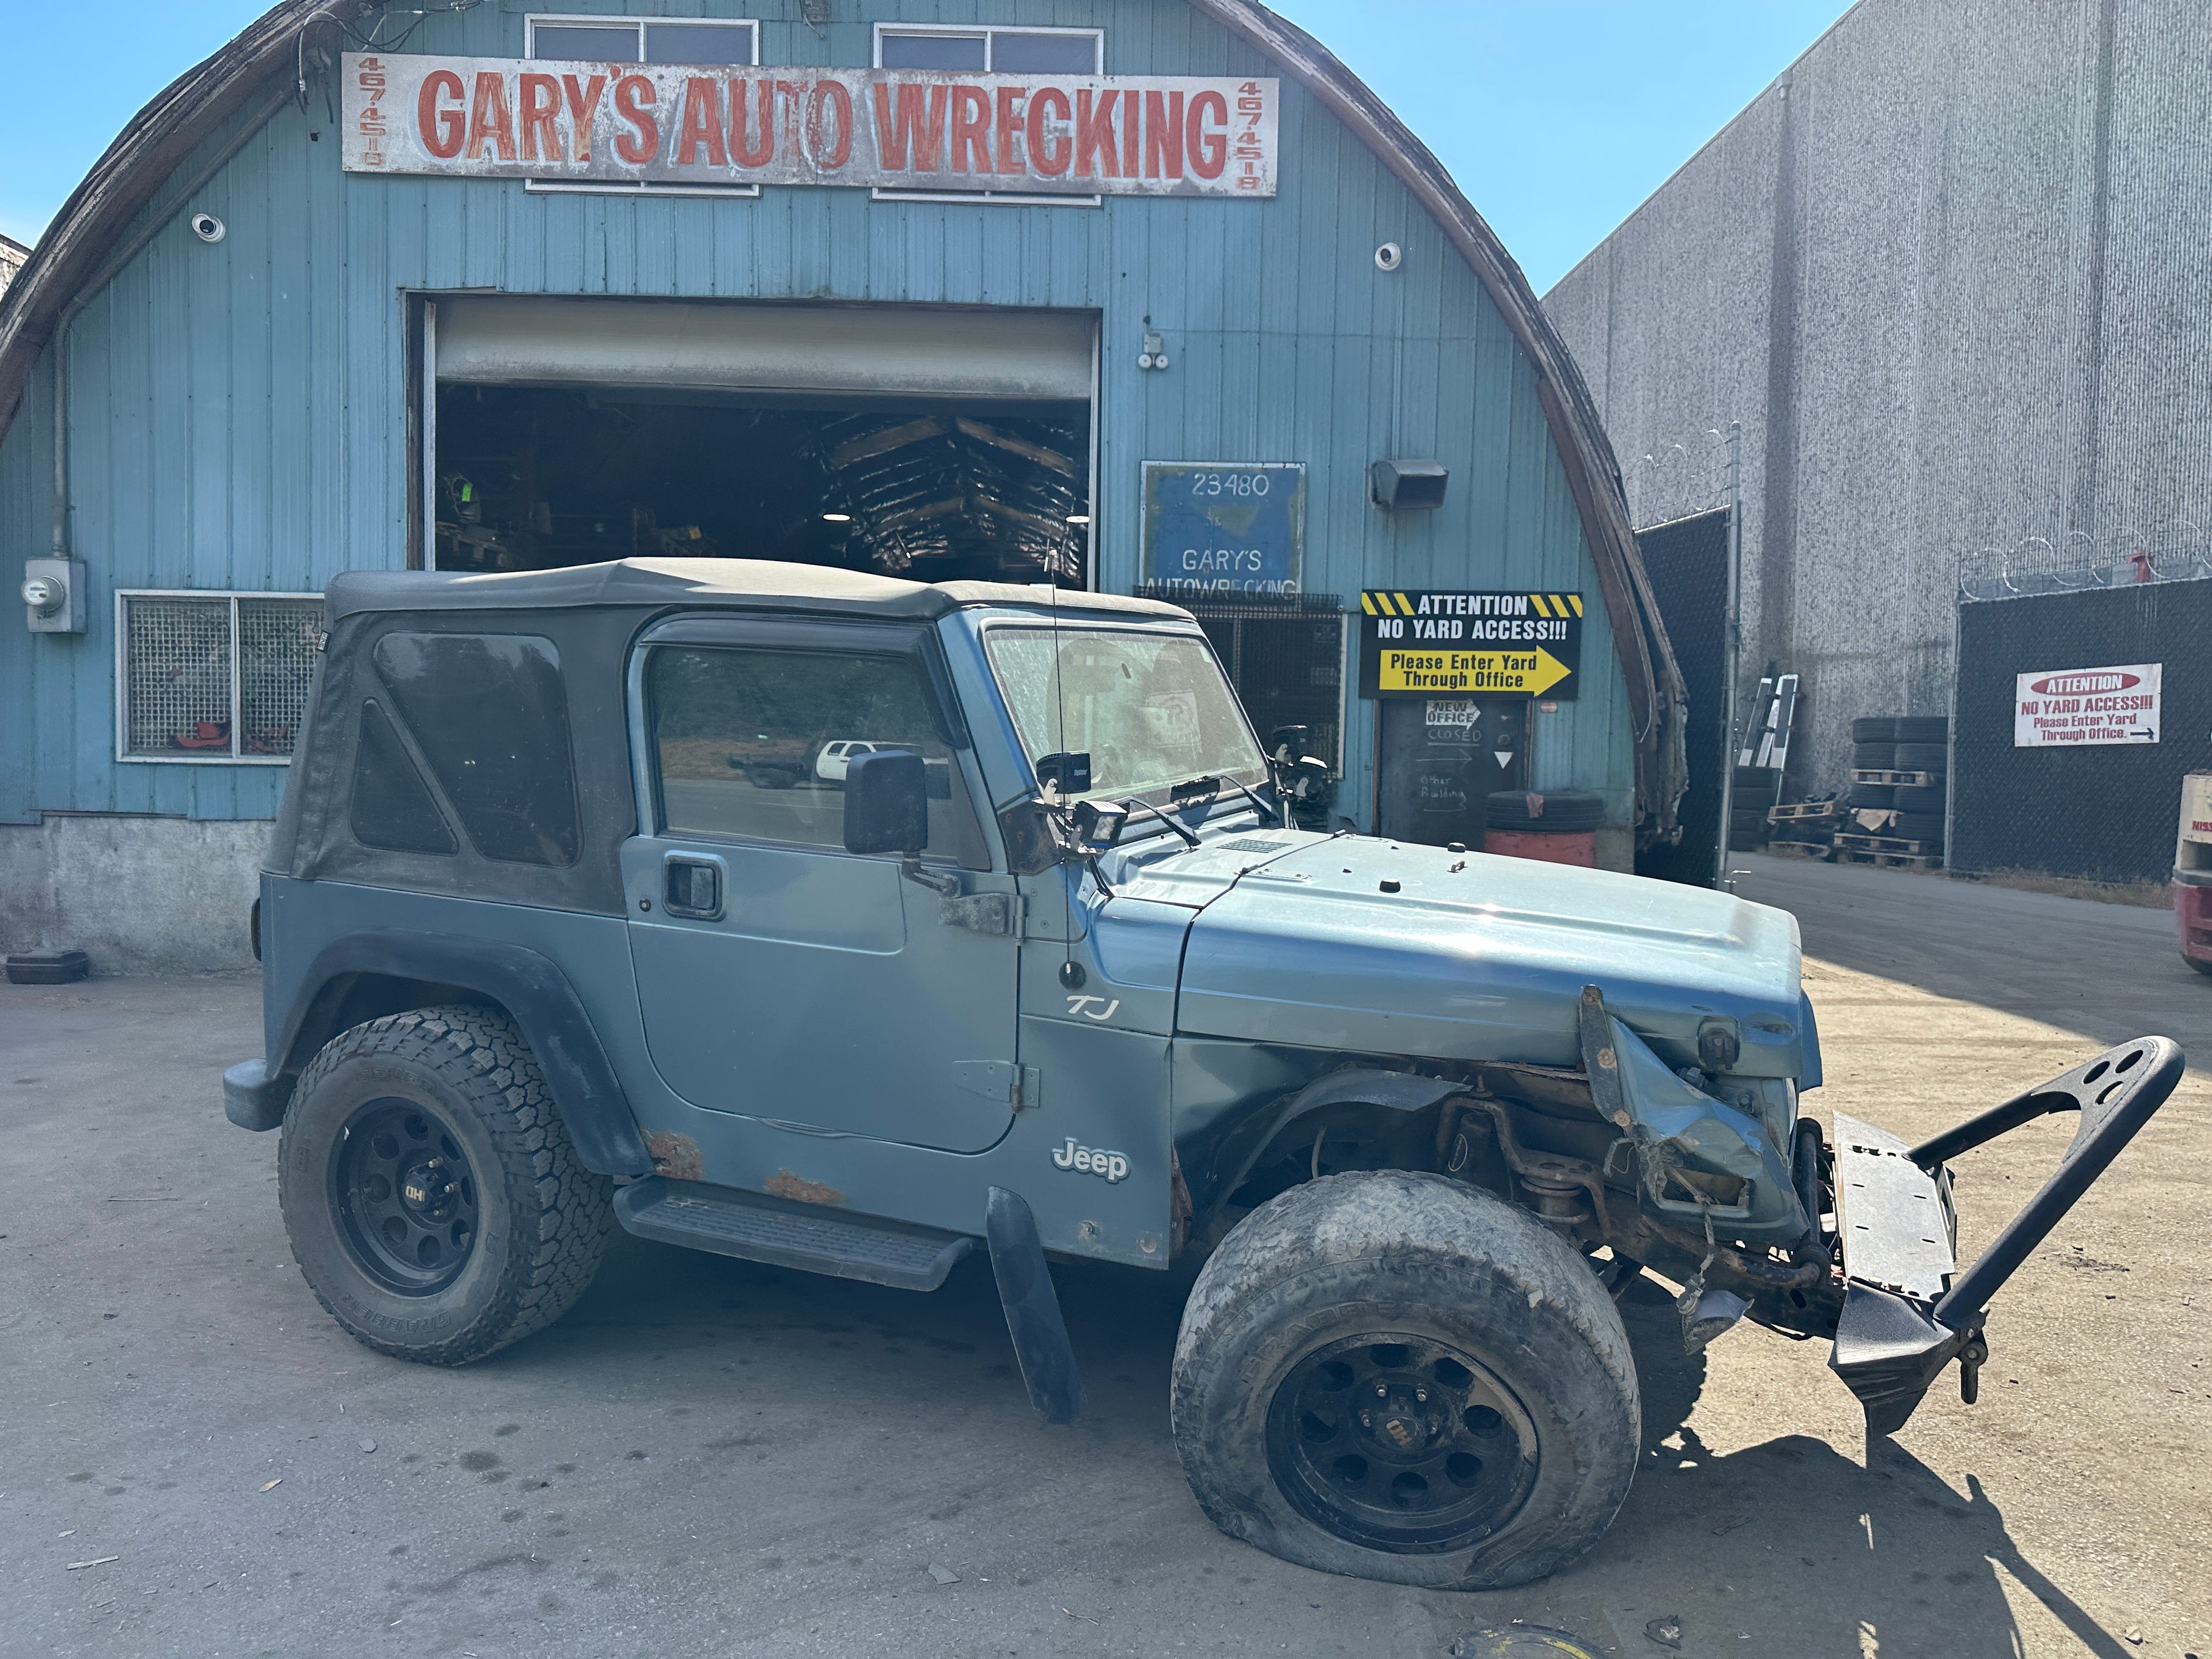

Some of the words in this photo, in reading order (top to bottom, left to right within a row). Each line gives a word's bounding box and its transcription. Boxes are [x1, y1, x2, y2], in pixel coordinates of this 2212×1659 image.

[417, 66, 657, 165] GARY'S
[679, 77, 853, 169] AUTO
[873, 82, 1228, 180] WRECKING
[1192, 473, 1268, 496] 23480
[1183, 550, 1262, 571] GARY'S
[1418, 594, 1528, 615] ATTENTION
[1377, 619, 1403, 639] NO
[1413, 619, 1463, 639] YARD
[1471, 620, 1567, 640] ACCESS!!!
[1391, 654, 1443, 669] Please
[1450, 654, 1494, 670] Enter
[1502, 654, 1537, 671] Yard
[1403, 671, 1468, 690] Through
[1475, 671, 1524, 687] Office
[2046, 674, 2123, 694] ATTENTION
[1433, 702, 1467, 712] NEW
[2021, 702, 2039, 715] NO
[2043, 699, 2080, 714] YARD
[2084, 695, 2153, 713] ACCESS!!!
[1427, 711, 1475, 723] OFFICE
[2033, 717, 2069, 729] Please
[2071, 715, 2103, 727] Enter
[2107, 713, 2137, 725] Yard
[1429, 729, 1482, 741] CLOSED
[2041, 729, 2086, 742] Through
[1066, 995, 1120, 1020] TJ
[1052, 1138, 1130, 1182] Jeep
